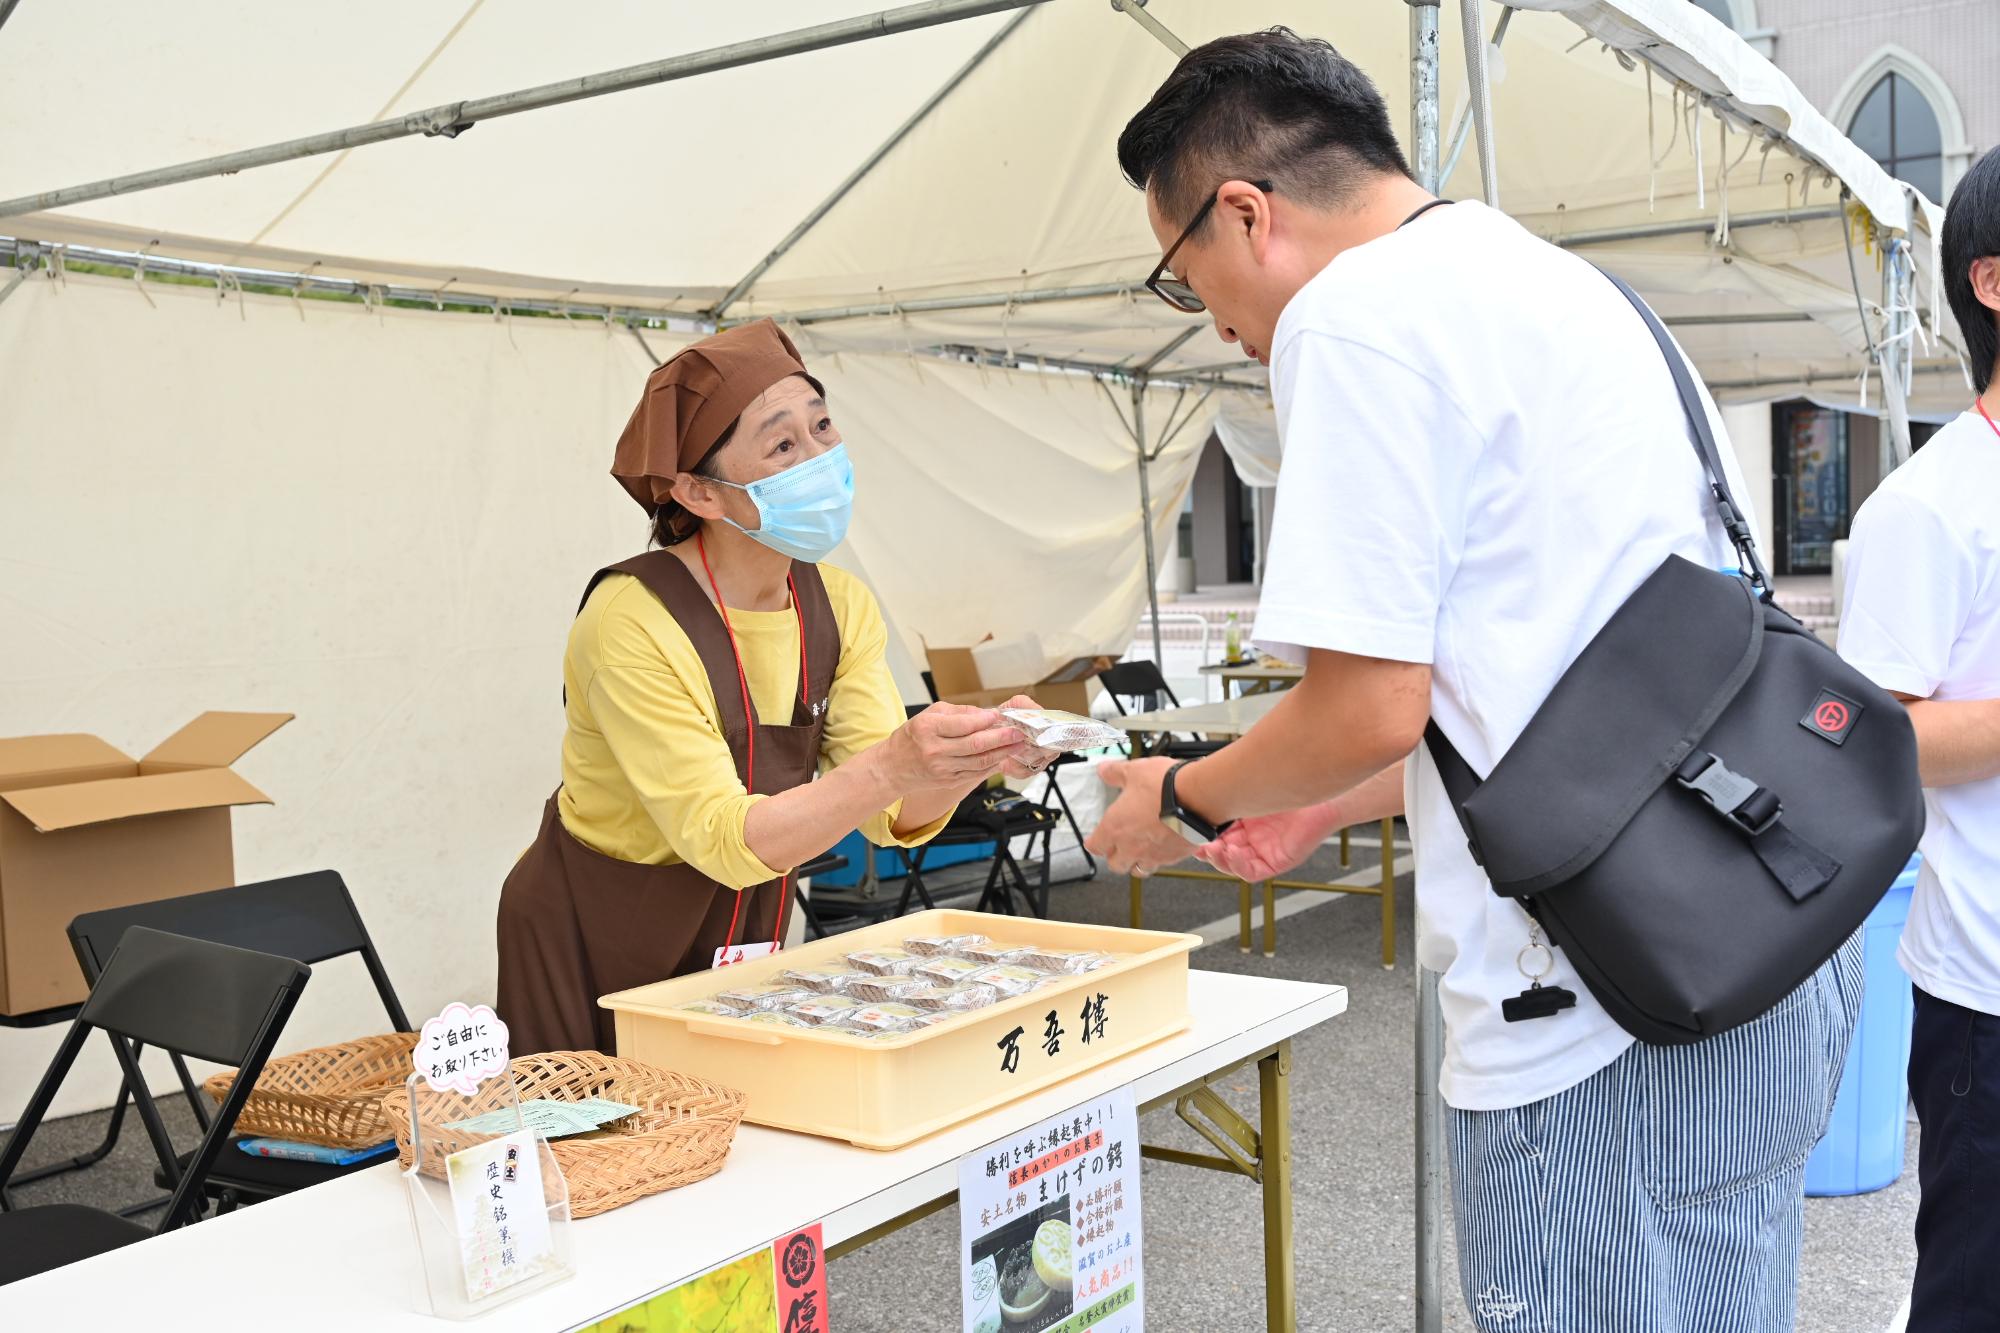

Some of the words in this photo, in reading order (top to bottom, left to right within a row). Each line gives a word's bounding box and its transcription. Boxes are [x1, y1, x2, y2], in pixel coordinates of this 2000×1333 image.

[432, 1024, 488, 1051] ご自由に
[431, 1047, 503, 1079] お取り下さい
[1008, 1133, 1102, 1186] 信長ゆかりのお菓子
[980, 1191, 1027, 1228] 安土名物
[1039, 1141, 1122, 1202] まけずの鍔
[1085, 1178, 1123, 1208] 必勝祈願
[1085, 1195, 1124, 1226] 合格祈願
[1086, 1218, 1115, 1243] 縁起物
[1078, 1231, 1132, 1272] 滋賀のお土産
